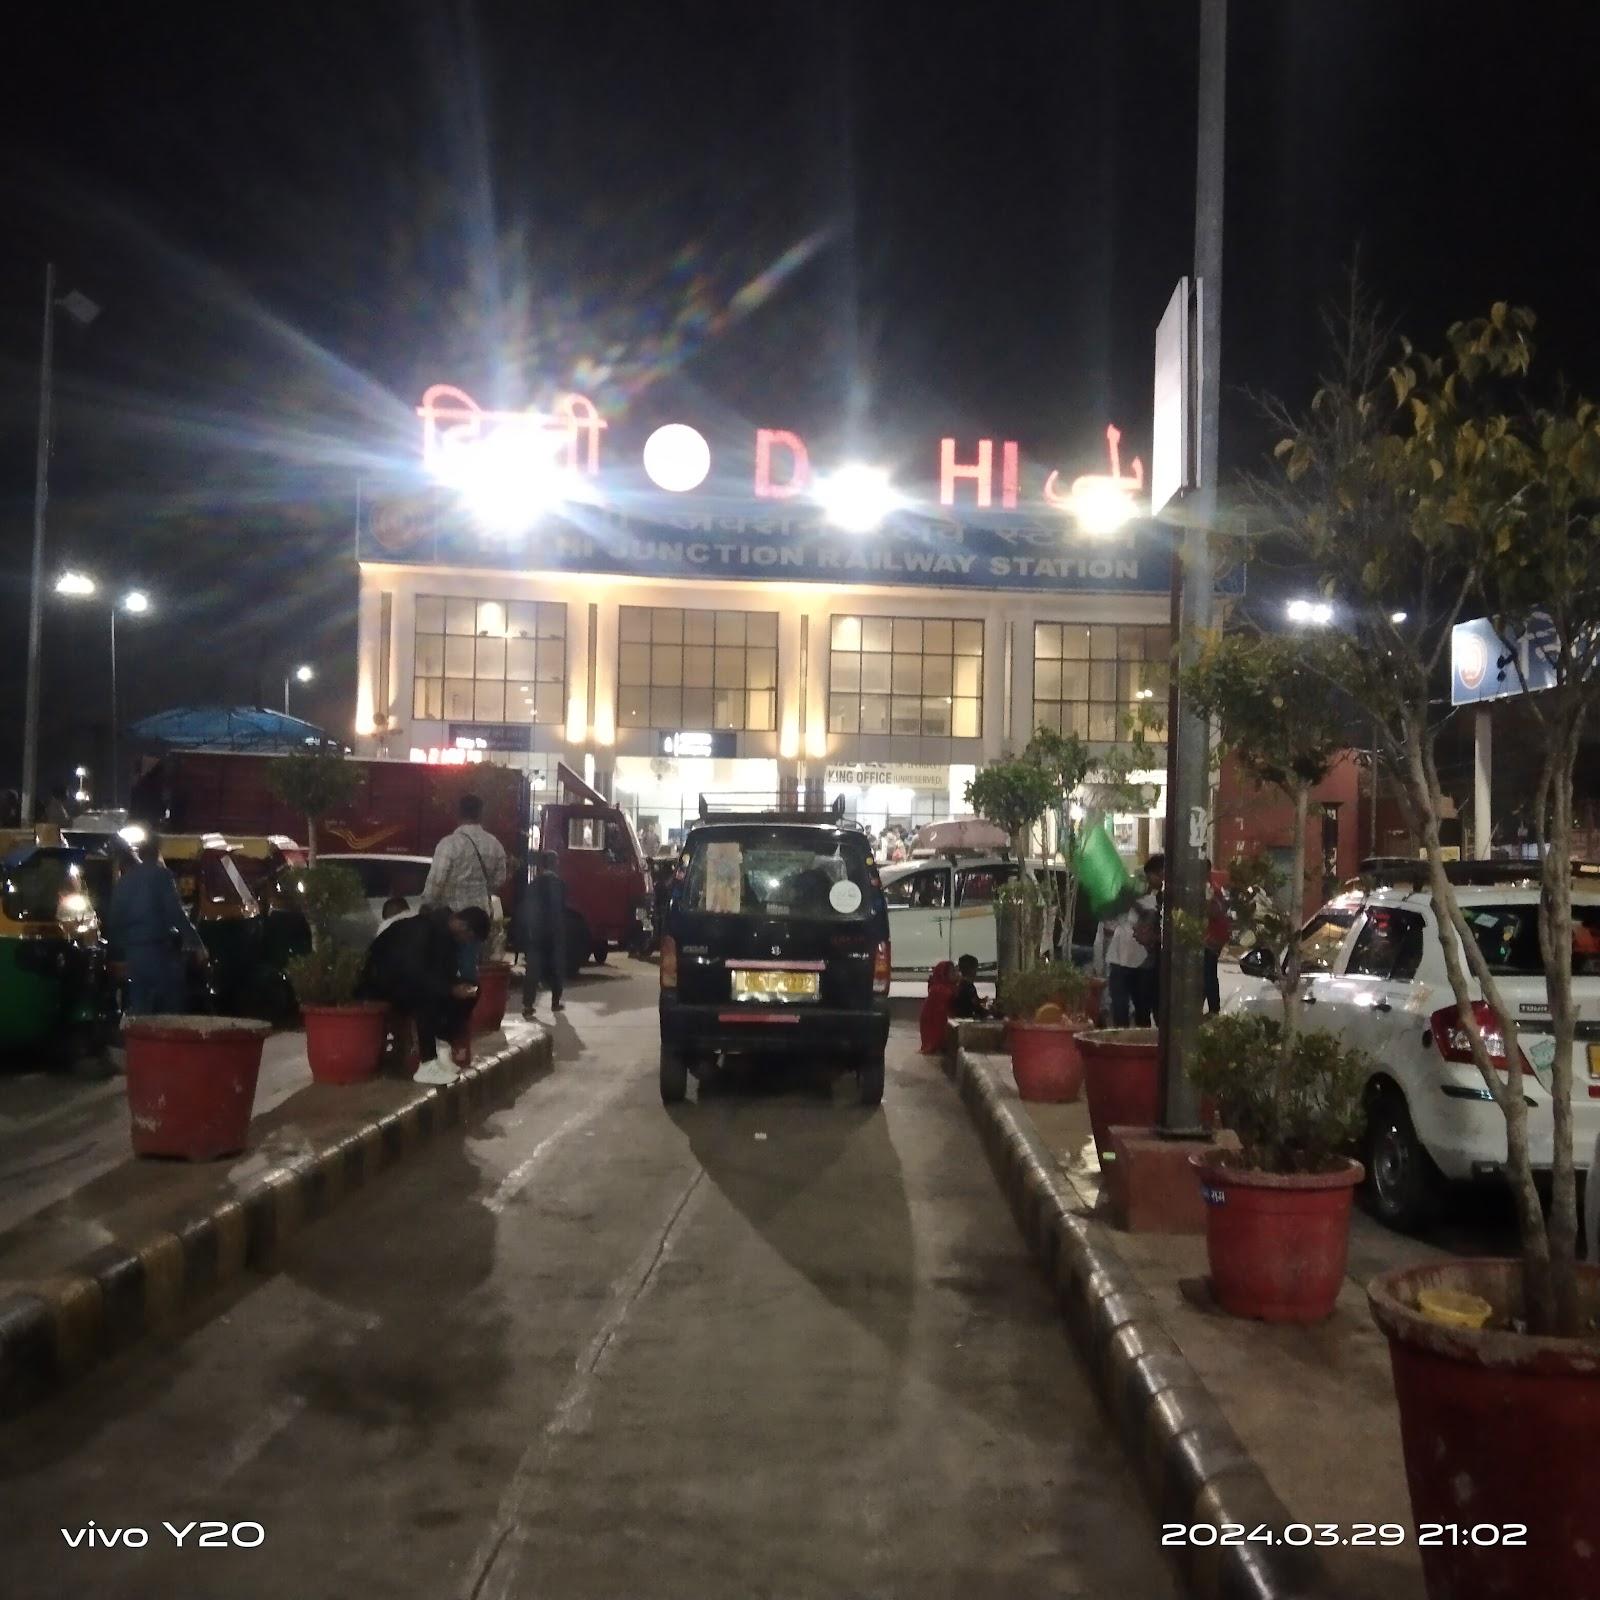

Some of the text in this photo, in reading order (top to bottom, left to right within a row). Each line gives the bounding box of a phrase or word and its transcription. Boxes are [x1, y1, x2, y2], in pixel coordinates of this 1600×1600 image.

[753, 428, 1019, 508] DHI
[610, 541, 806, 567] JUNCTION
[817, 547, 976, 575] RAILWAY
[989, 555, 1139, 580] STATION
[856, 771, 892, 785] OFFICE
